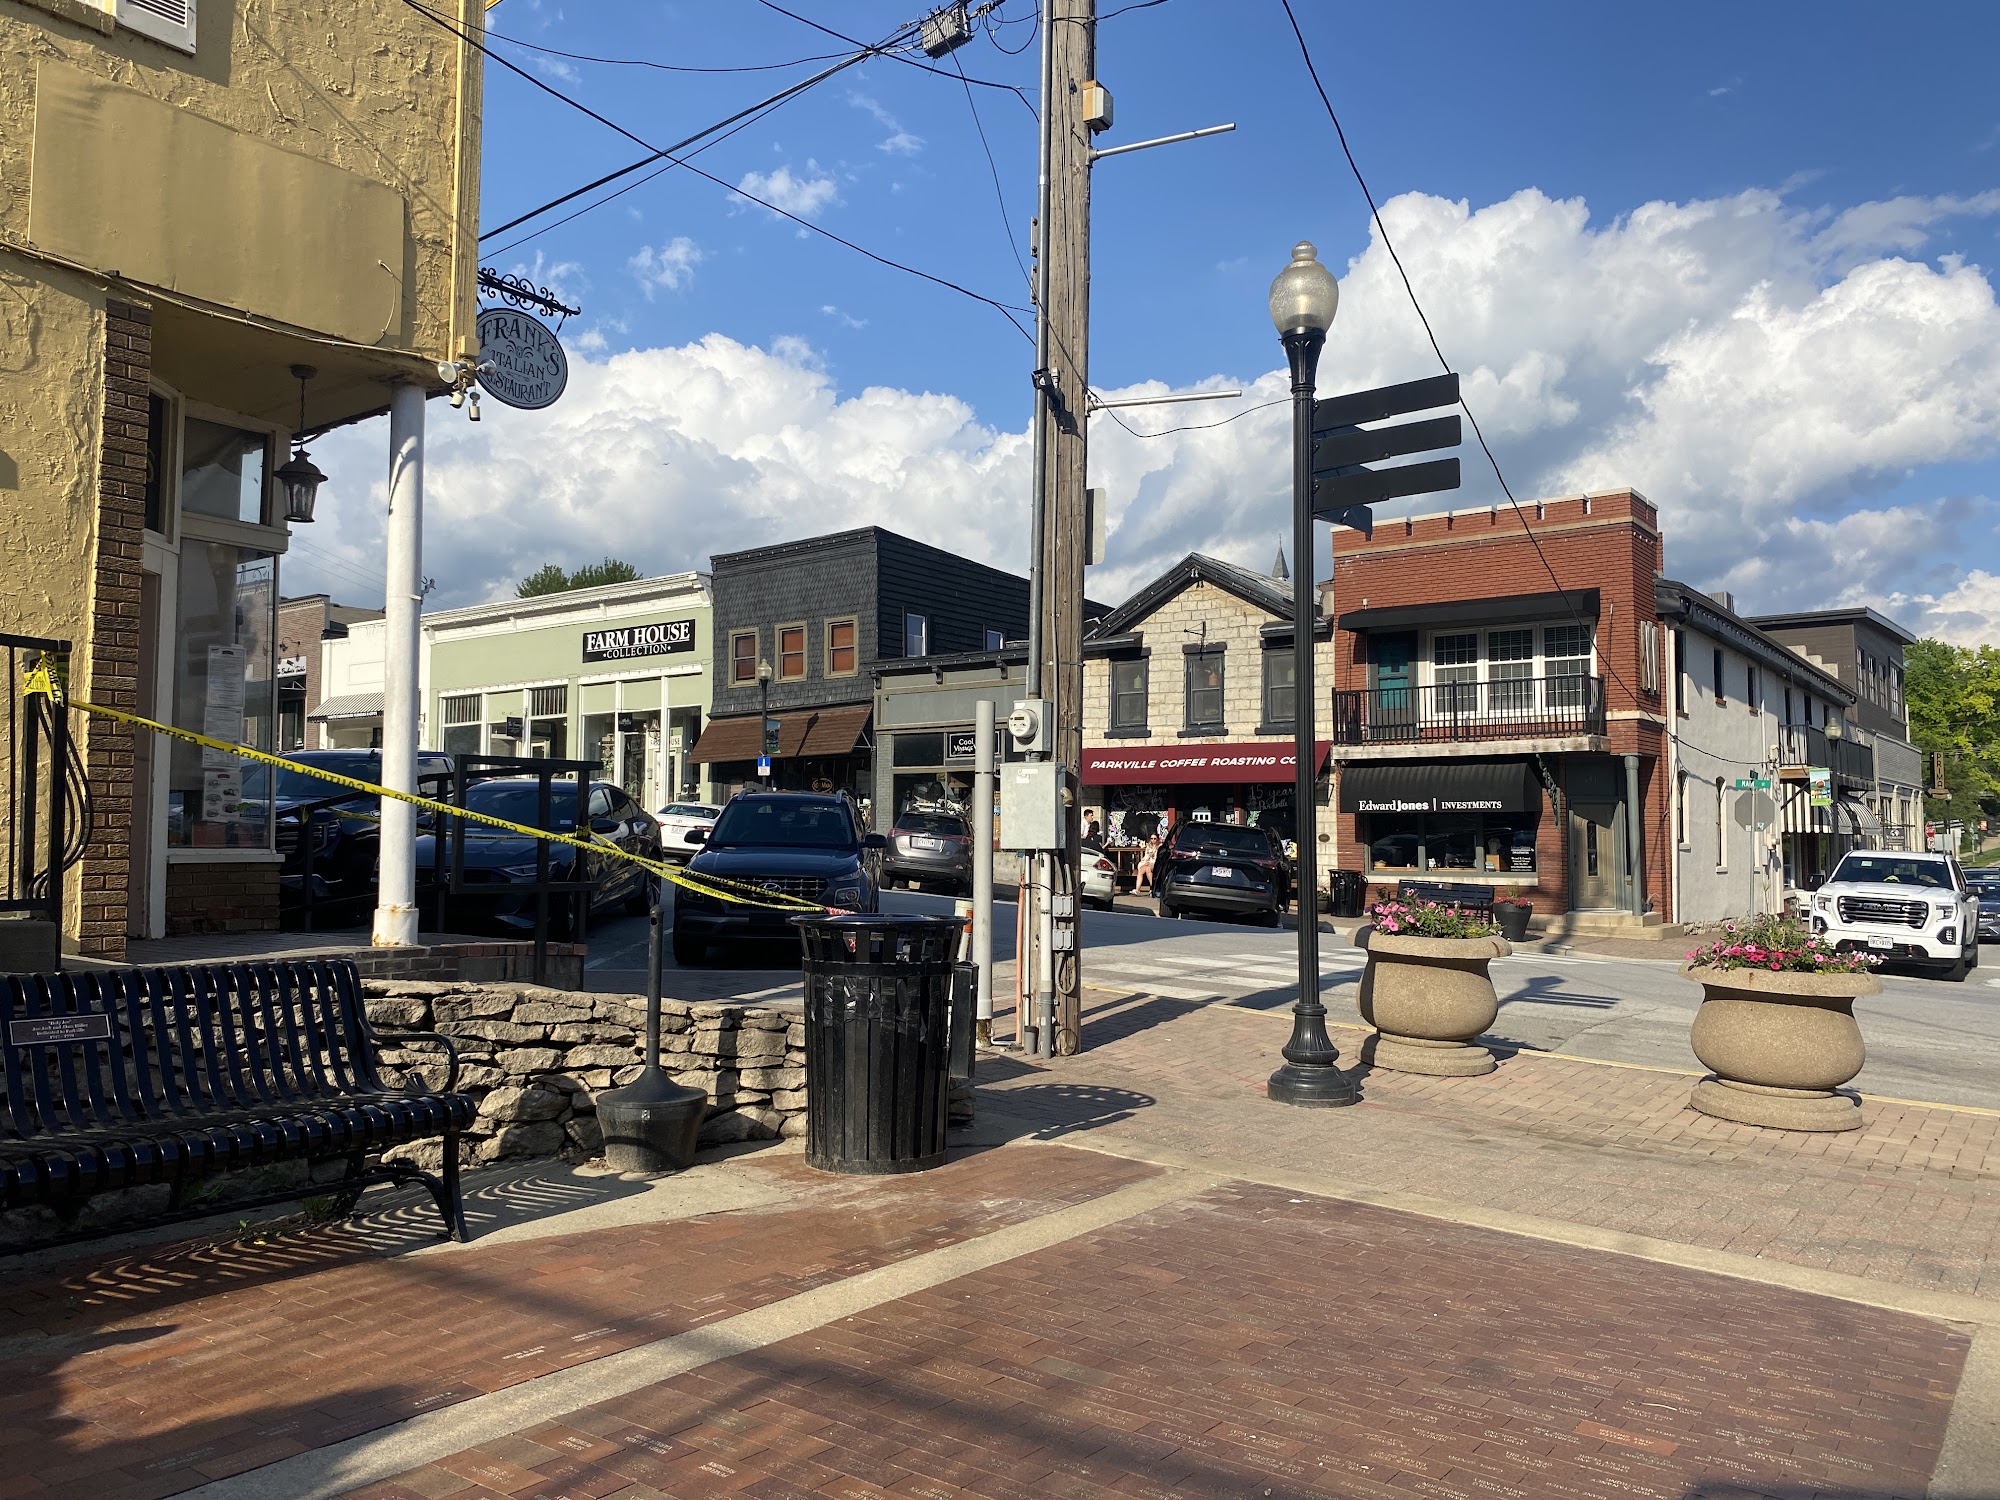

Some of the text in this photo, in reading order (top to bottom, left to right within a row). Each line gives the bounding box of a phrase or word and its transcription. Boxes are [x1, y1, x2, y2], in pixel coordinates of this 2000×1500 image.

[491, 348, 546, 381] ITALIAN
[586, 622, 691, 650] FARM HOUSE
[958, 738, 974, 746] Cool
[1090, 760, 1158, 769] PARKVILLE
[1160, 758, 1208, 768] COFFEE
[1210, 756, 1277, 766] ROASTING
[1936, 752, 1944, 788] PRIMA
[1441, 800, 1503, 810] INVESTMENTS
